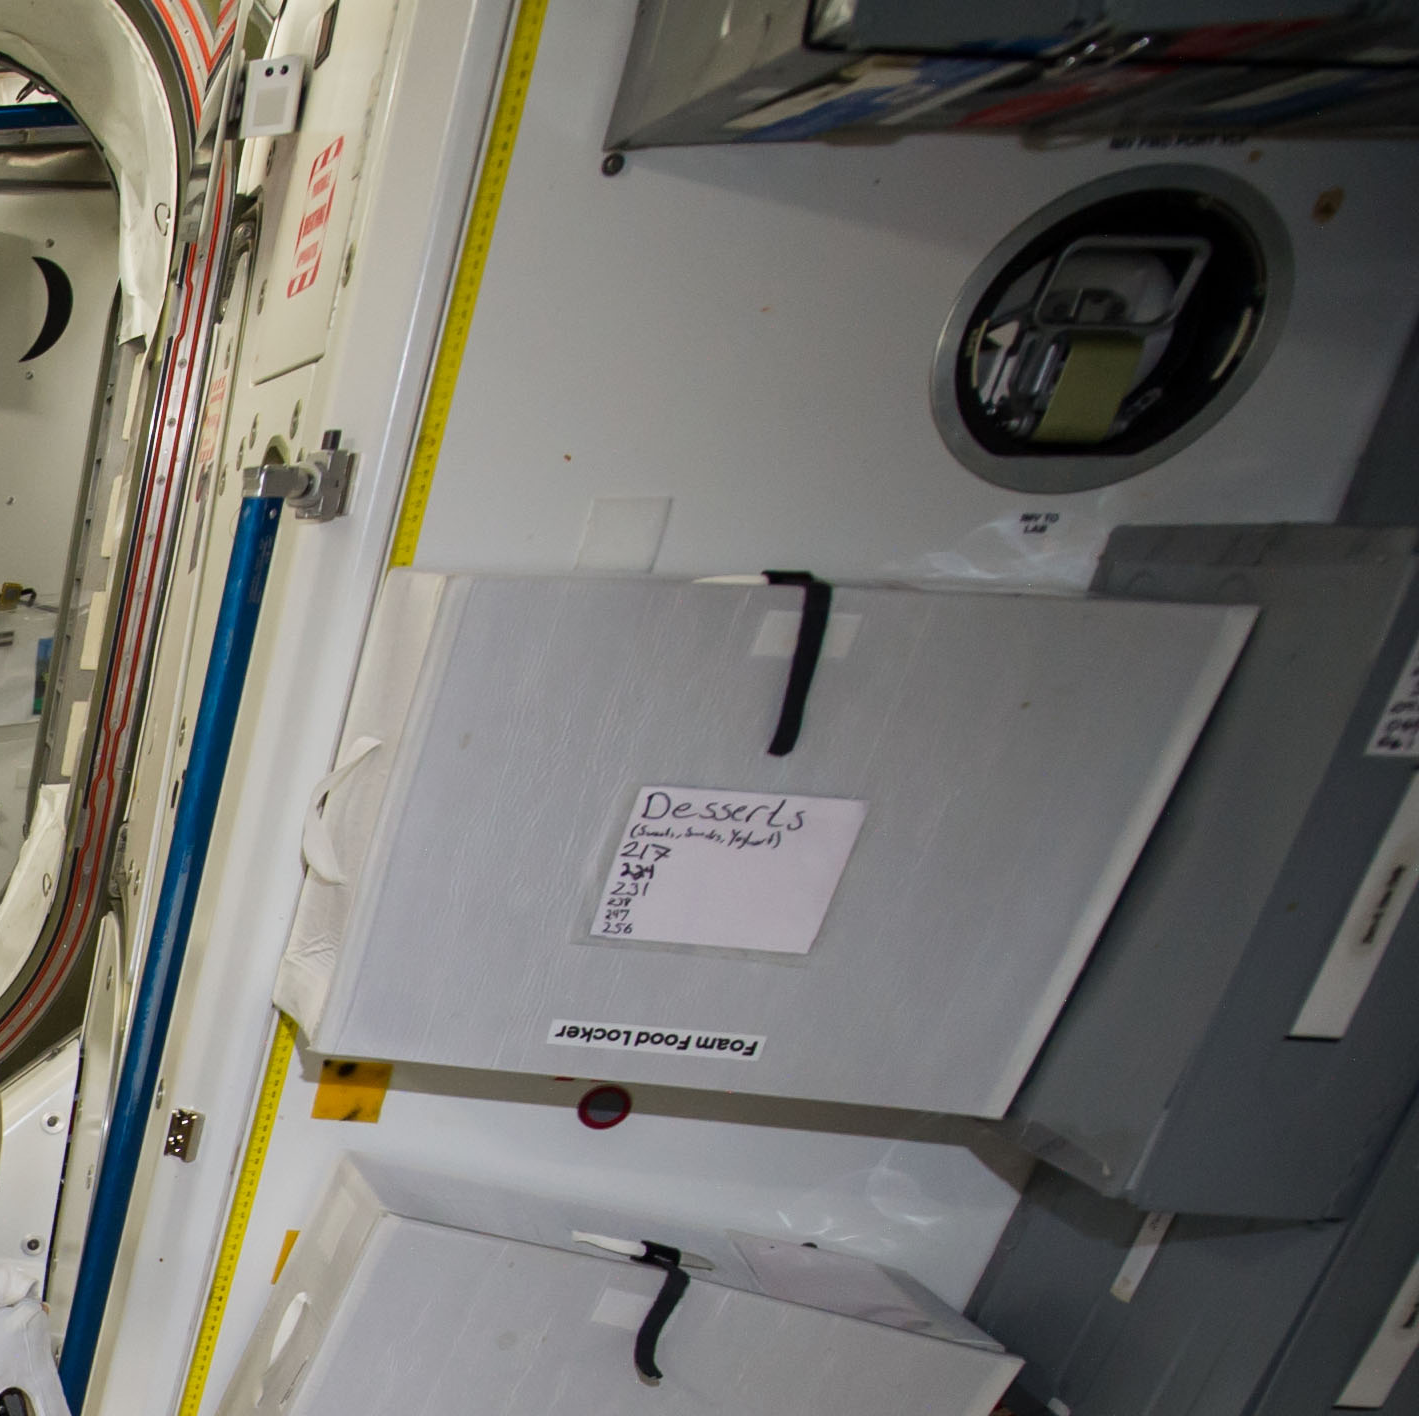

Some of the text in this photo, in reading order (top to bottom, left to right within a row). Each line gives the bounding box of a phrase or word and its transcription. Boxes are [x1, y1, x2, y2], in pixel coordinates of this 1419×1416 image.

[641, 791, 806, 833] Desserts
[620, 841, 671, 861] 217
[610, 881, 650, 897] 231
[601, 921, 634, 935] 256
[555, 1022, 759, 1057] Foam Food Locker
